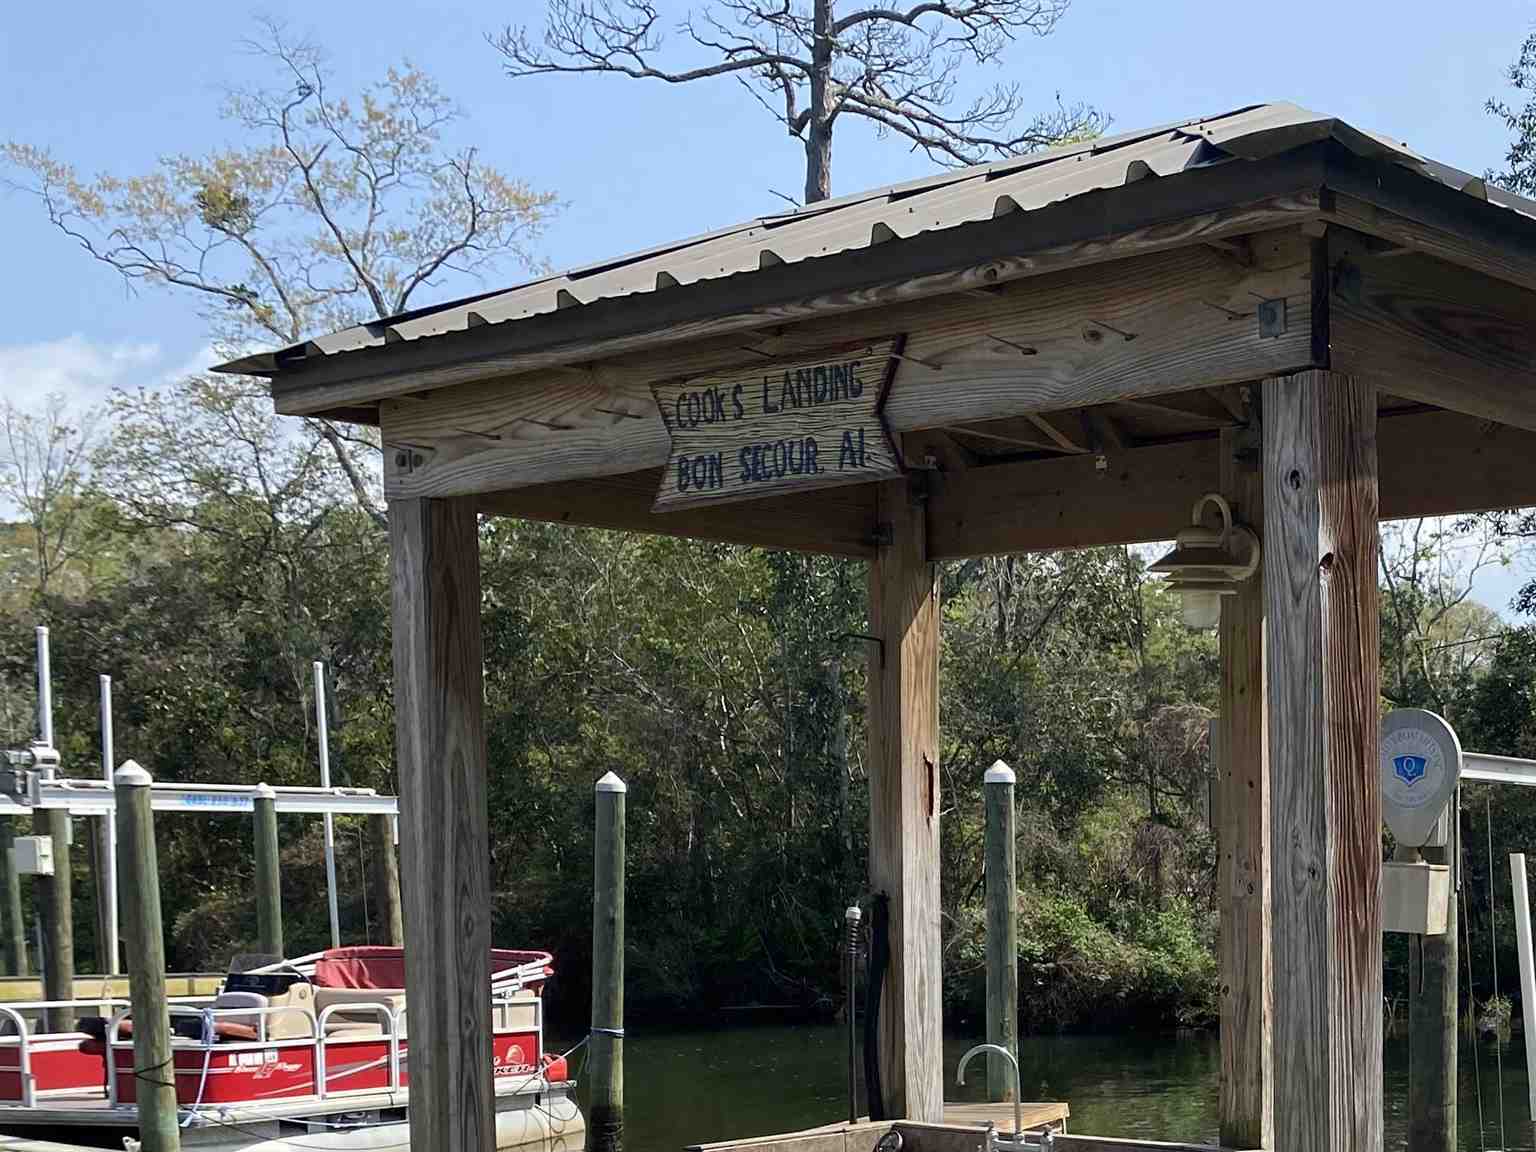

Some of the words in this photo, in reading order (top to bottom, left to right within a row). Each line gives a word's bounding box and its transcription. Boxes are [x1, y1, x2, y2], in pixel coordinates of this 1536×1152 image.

[763, 361, 863, 413] LANDING
[678, 451, 723, 493] BON
[1403, 757, 1416, 776] Q
